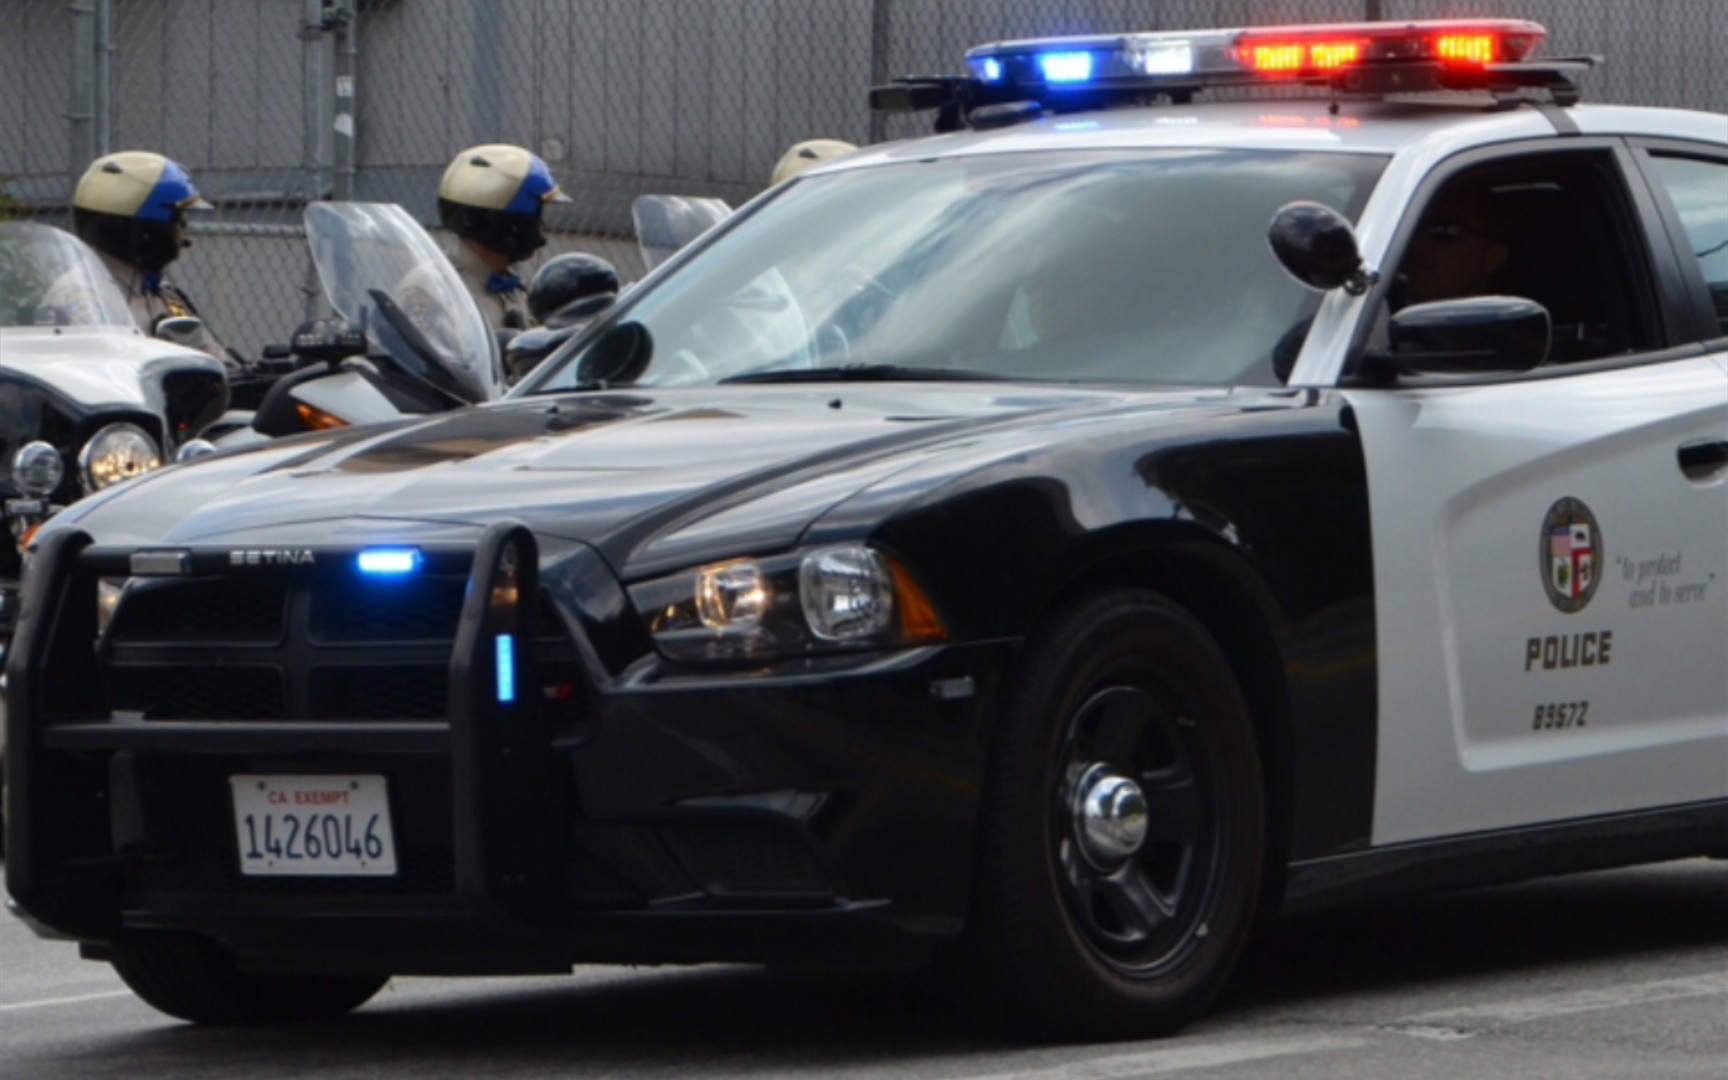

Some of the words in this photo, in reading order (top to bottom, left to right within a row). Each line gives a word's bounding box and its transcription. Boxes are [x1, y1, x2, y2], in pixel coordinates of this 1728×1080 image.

[230, 549, 315, 565] SETINA
[1638, 552, 1681, 583] protect
[1629, 580, 1656, 608] and
[1658, 581, 1673, 605] to
[1525, 631, 1612, 671] POLICE
[268, 791, 288, 805] CA
[296, 790, 351, 805] EXEMPT
[245, 814, 383, 858] 1426046
